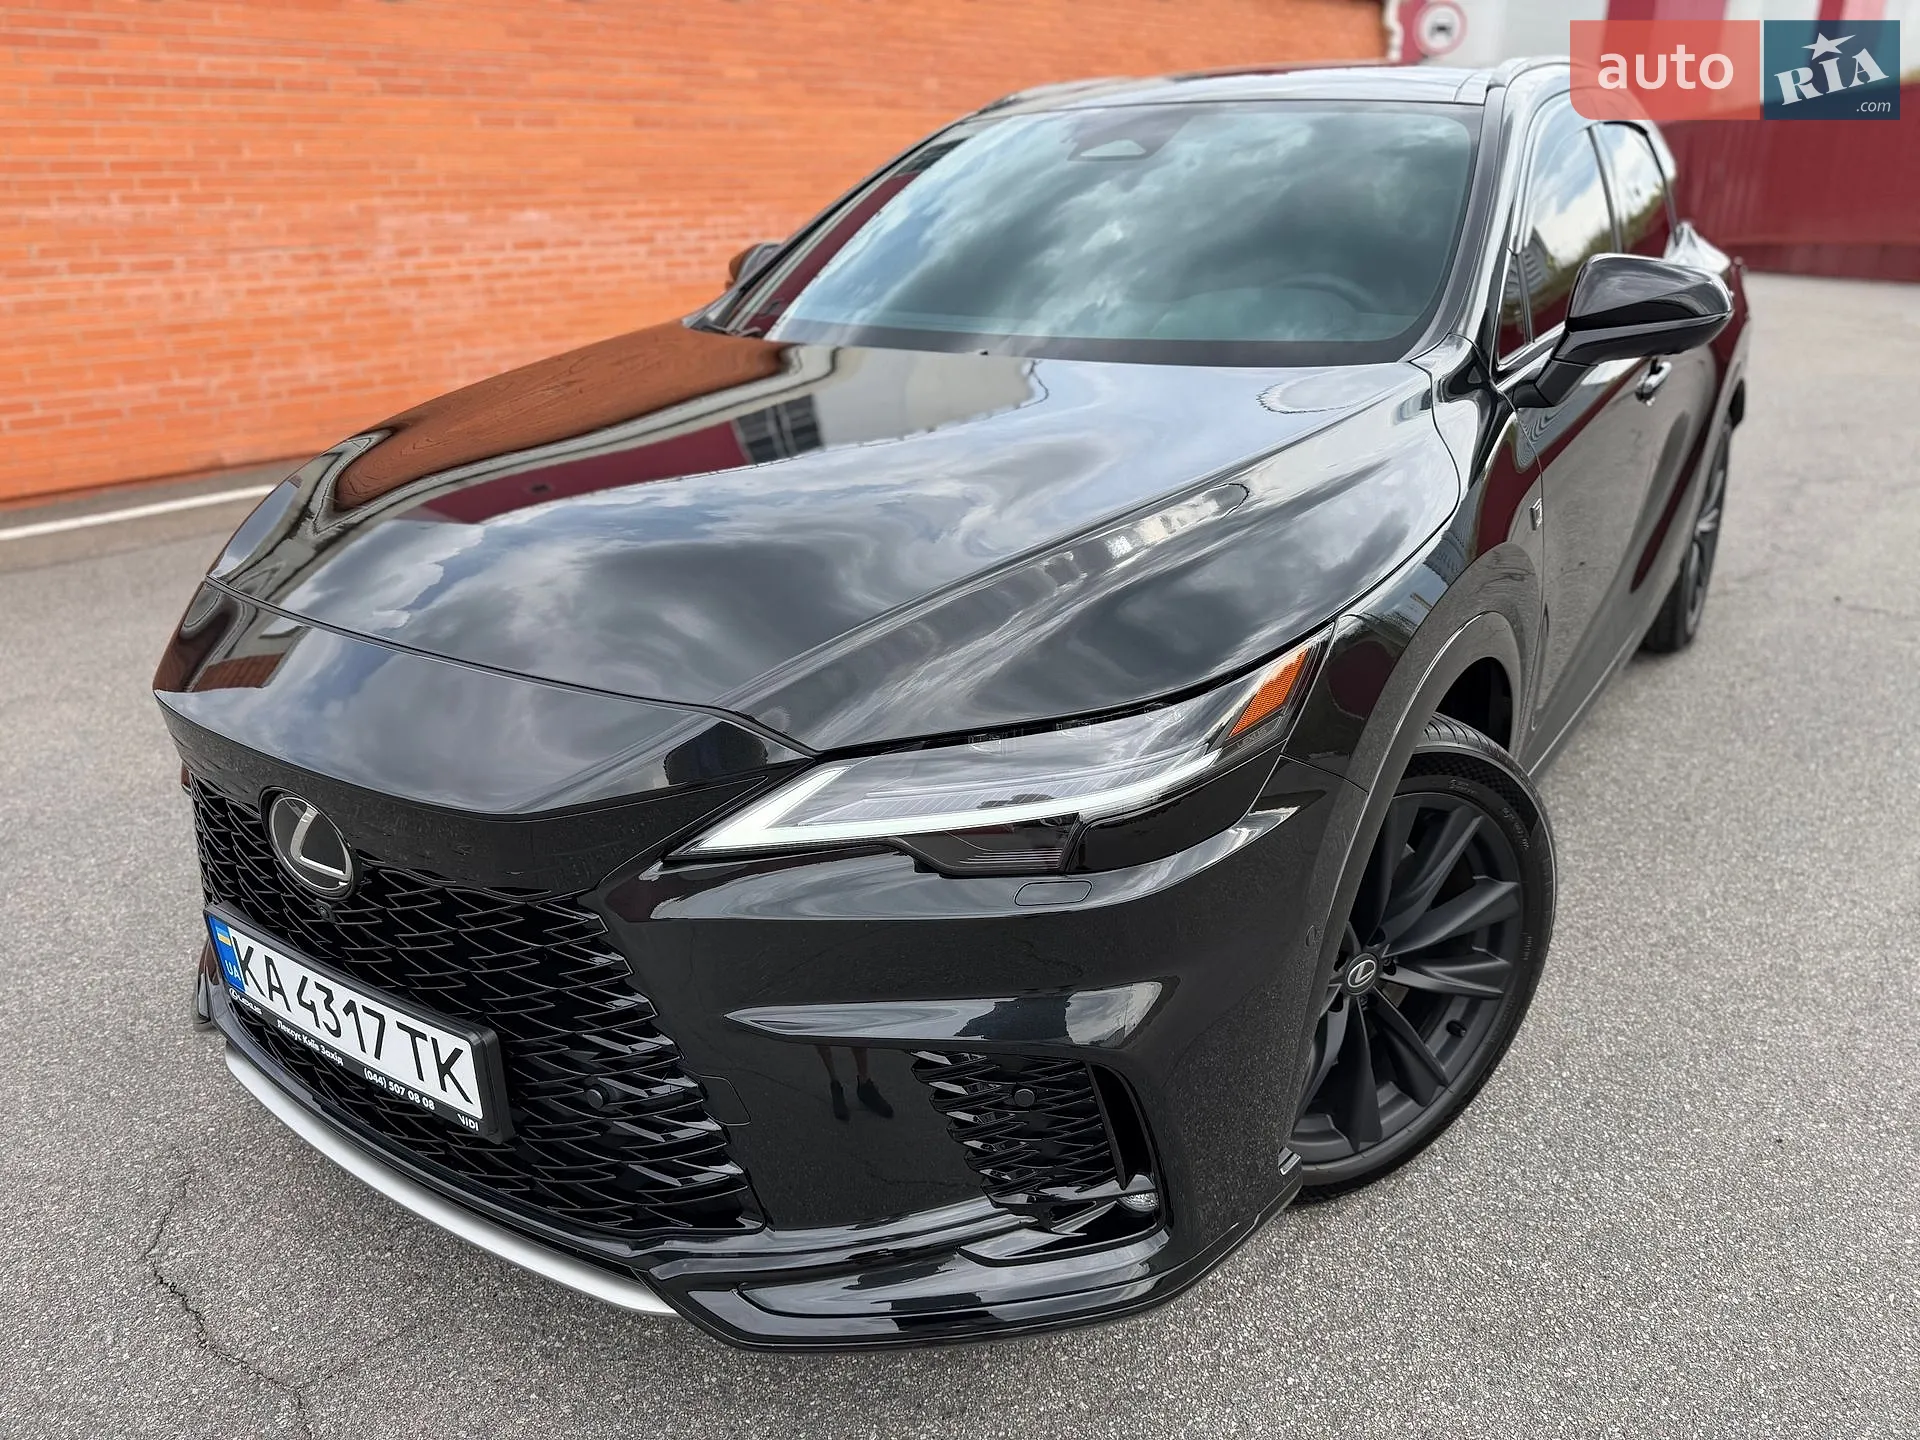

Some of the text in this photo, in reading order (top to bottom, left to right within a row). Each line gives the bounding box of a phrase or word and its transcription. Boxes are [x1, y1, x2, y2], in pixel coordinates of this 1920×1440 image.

[225, 959, 241, 982] UA
[232, 936, 473, 1105] KA 4317 TK
[320, 1044, 344, 1067] Захід
[363, 1067, 435, 1110] (044) 507 08 08
[457, 1113, 480, 1132] VIDI
